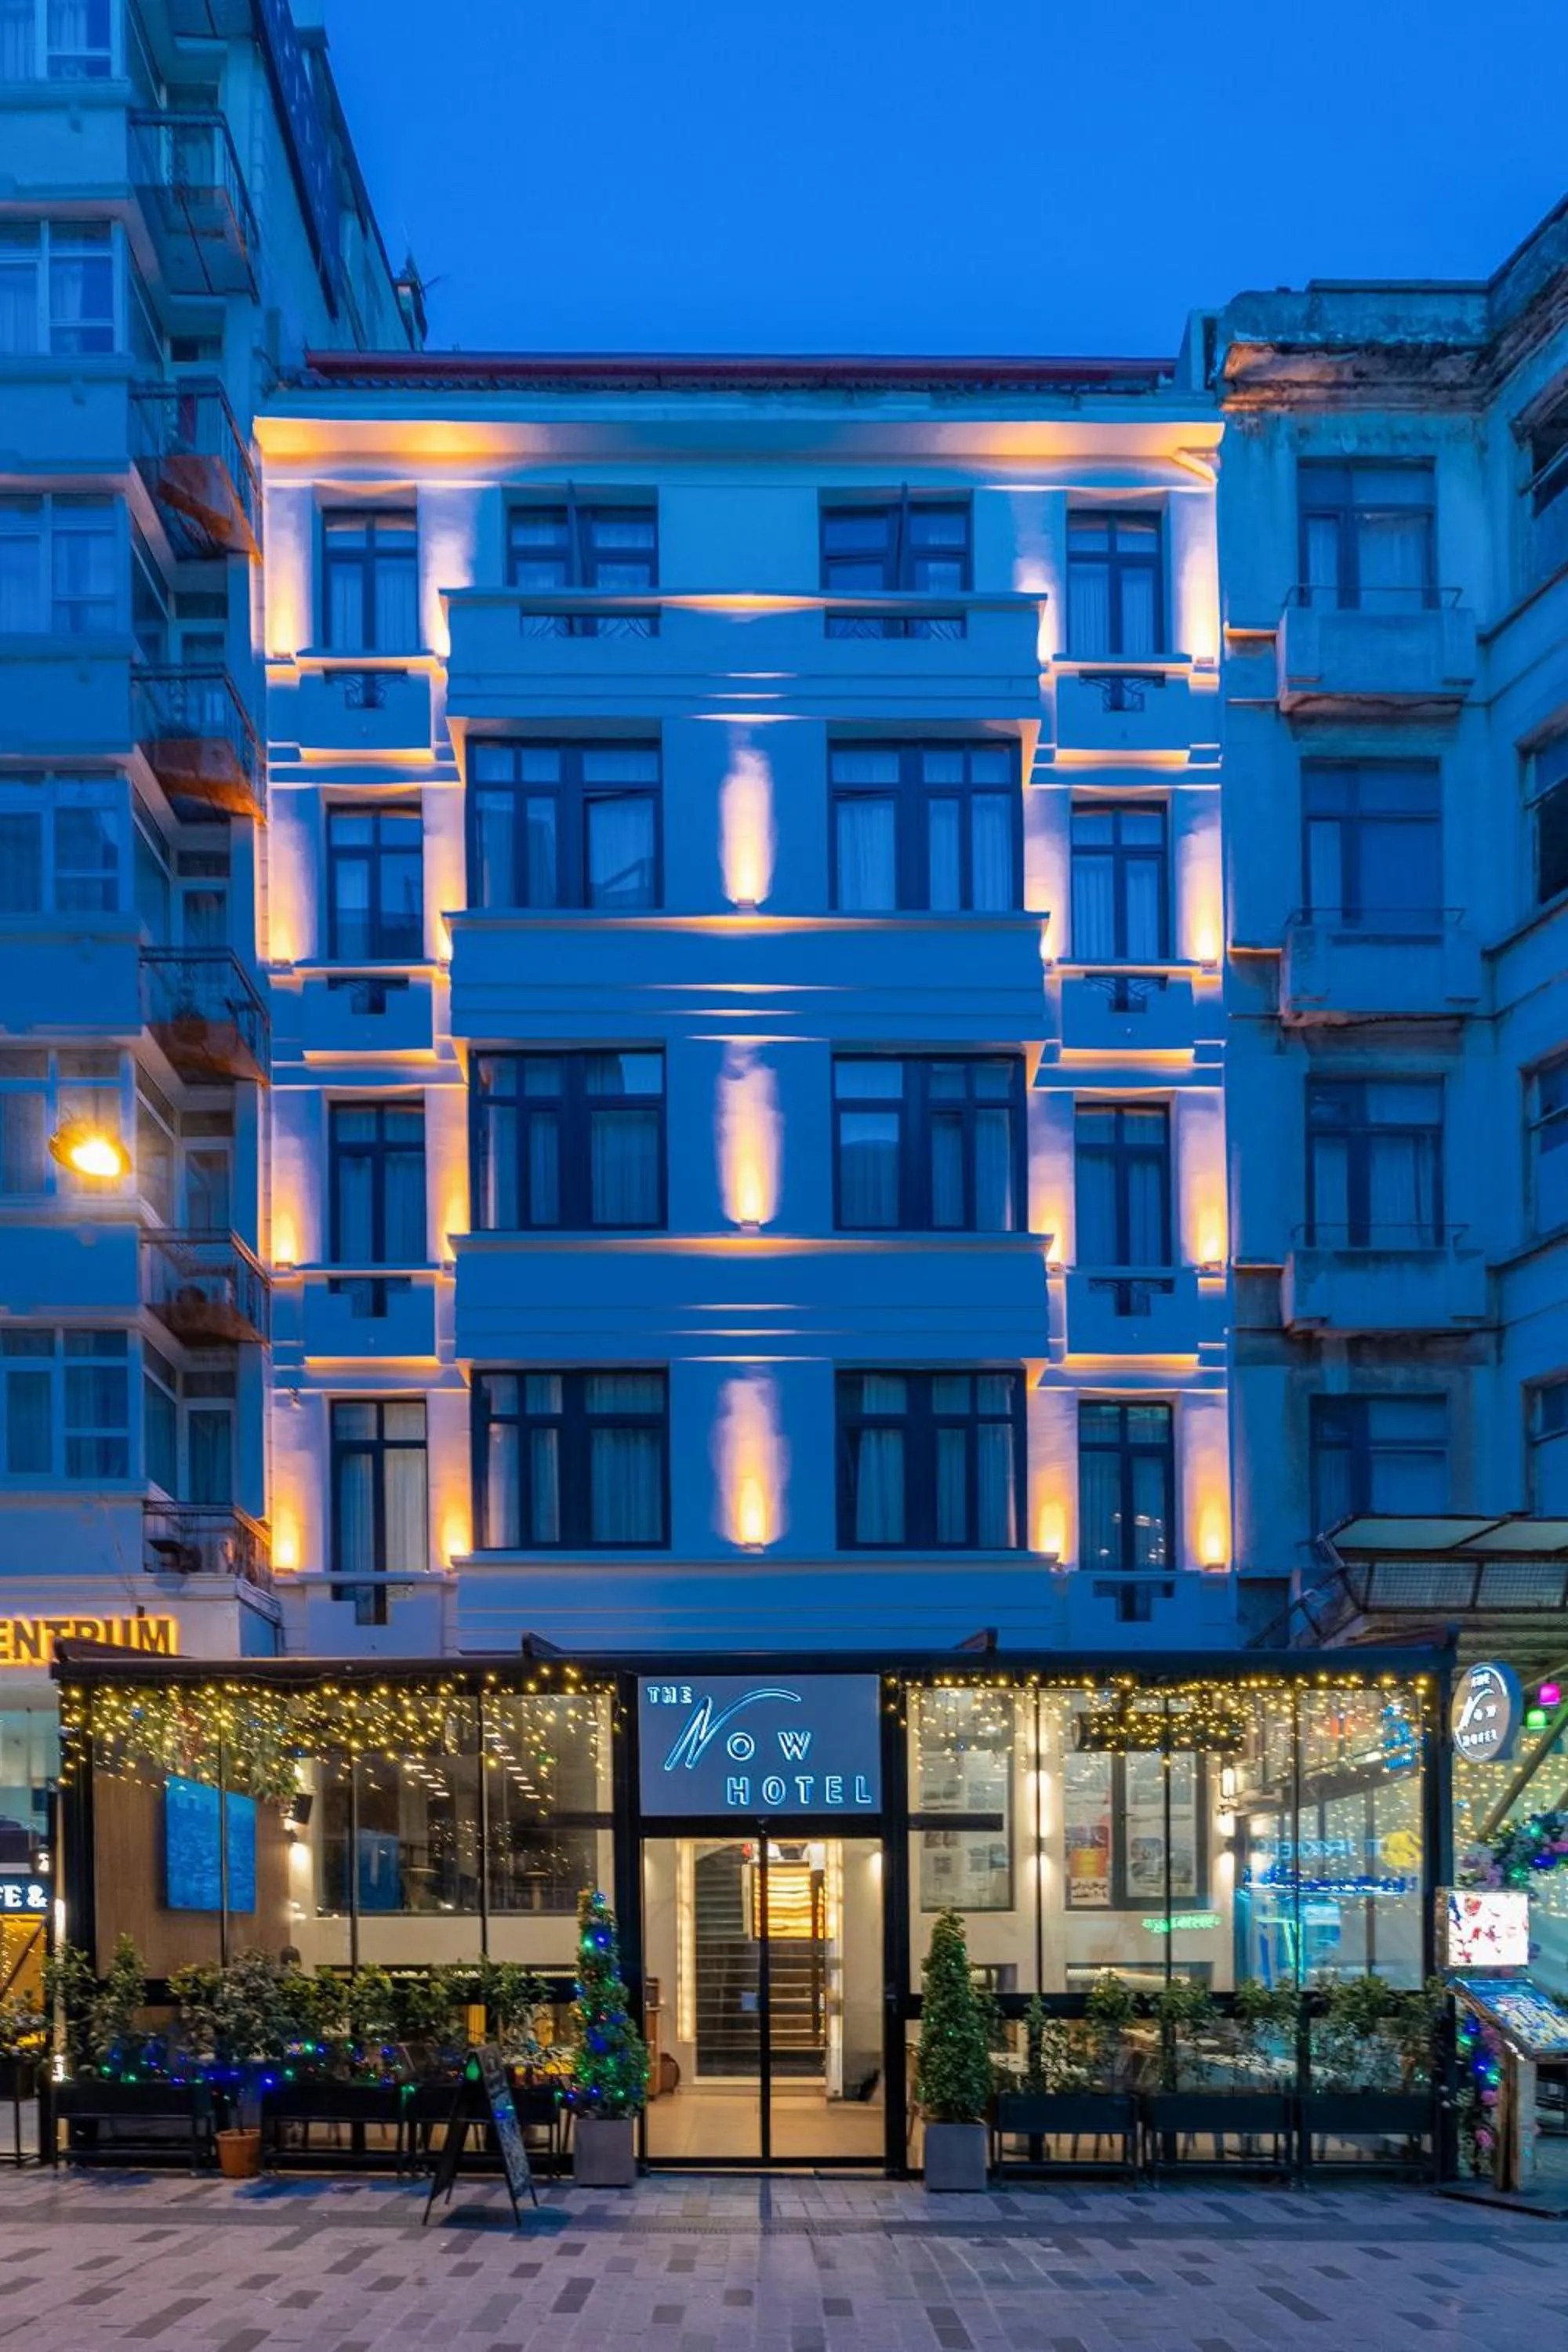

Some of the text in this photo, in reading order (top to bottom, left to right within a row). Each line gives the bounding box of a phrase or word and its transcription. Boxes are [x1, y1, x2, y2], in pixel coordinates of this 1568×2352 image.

[647, 1686, 693, 1704] THE
[664, 1688, 812, 1772] NOW
[727, 1776, 873, 1806] HOTEL
[27, 1884, 48, 1907] &
